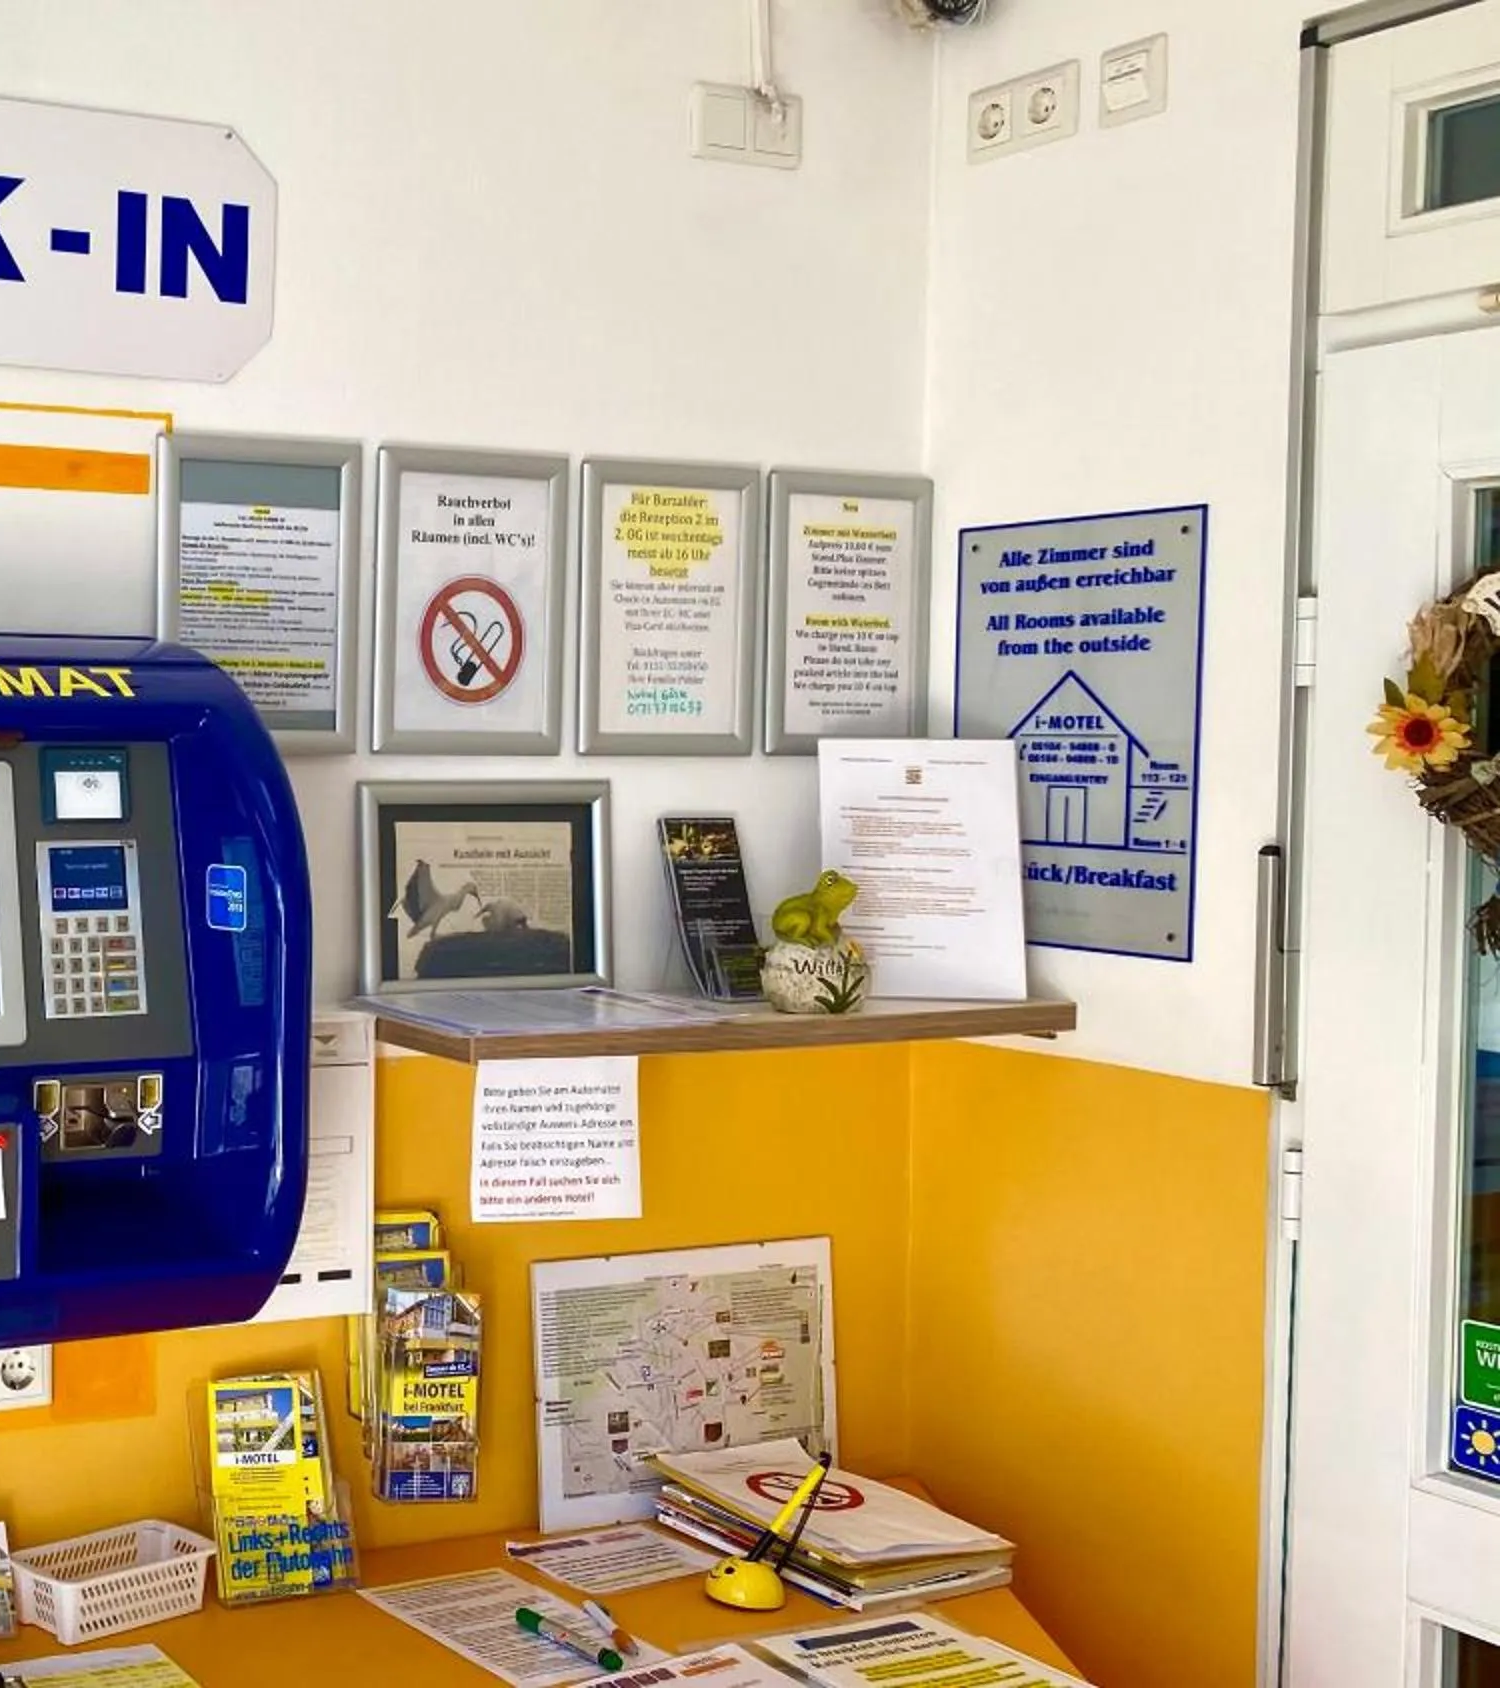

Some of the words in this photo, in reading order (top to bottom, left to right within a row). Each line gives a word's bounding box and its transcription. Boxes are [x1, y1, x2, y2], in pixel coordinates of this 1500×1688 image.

[115, 189, 250, 305] IN
[436, 495, 512, 511] Rauchverbot
[453, 513, 465, 526] in
[467, 514, 495, 527] allen
[639, 512, 693, 526] Rezeption
[411, 530, 461, 544] Räumen
[627, 528, 643, 541] OG
[691, 549, 710, 561] Uhr
[999, 550, 1032, 567] Alle
[1037, 546, 1108, 564] Zimmer
[1112, 539, 1155, 558] sind
[980, 579, 1010, 594] von
[1015, 574, 1071, 592] außen
[1076, 567, 1177, 588] erreichbar
[986, 614, 1009, 631] All
[1014, 613, 1074, 630] Rooms
[1079, 606, 1166, 627] available
[997, 639, 1038, 656] from
[1043, 637, 1073, 654] the
[1078, 634, 1152, 653] outside
[1035, 715, 1104, 730] i-MOTEL
[507, 1086, 537, 1099] geben
[403, 1383, 465, 1398] i-MOTEL
